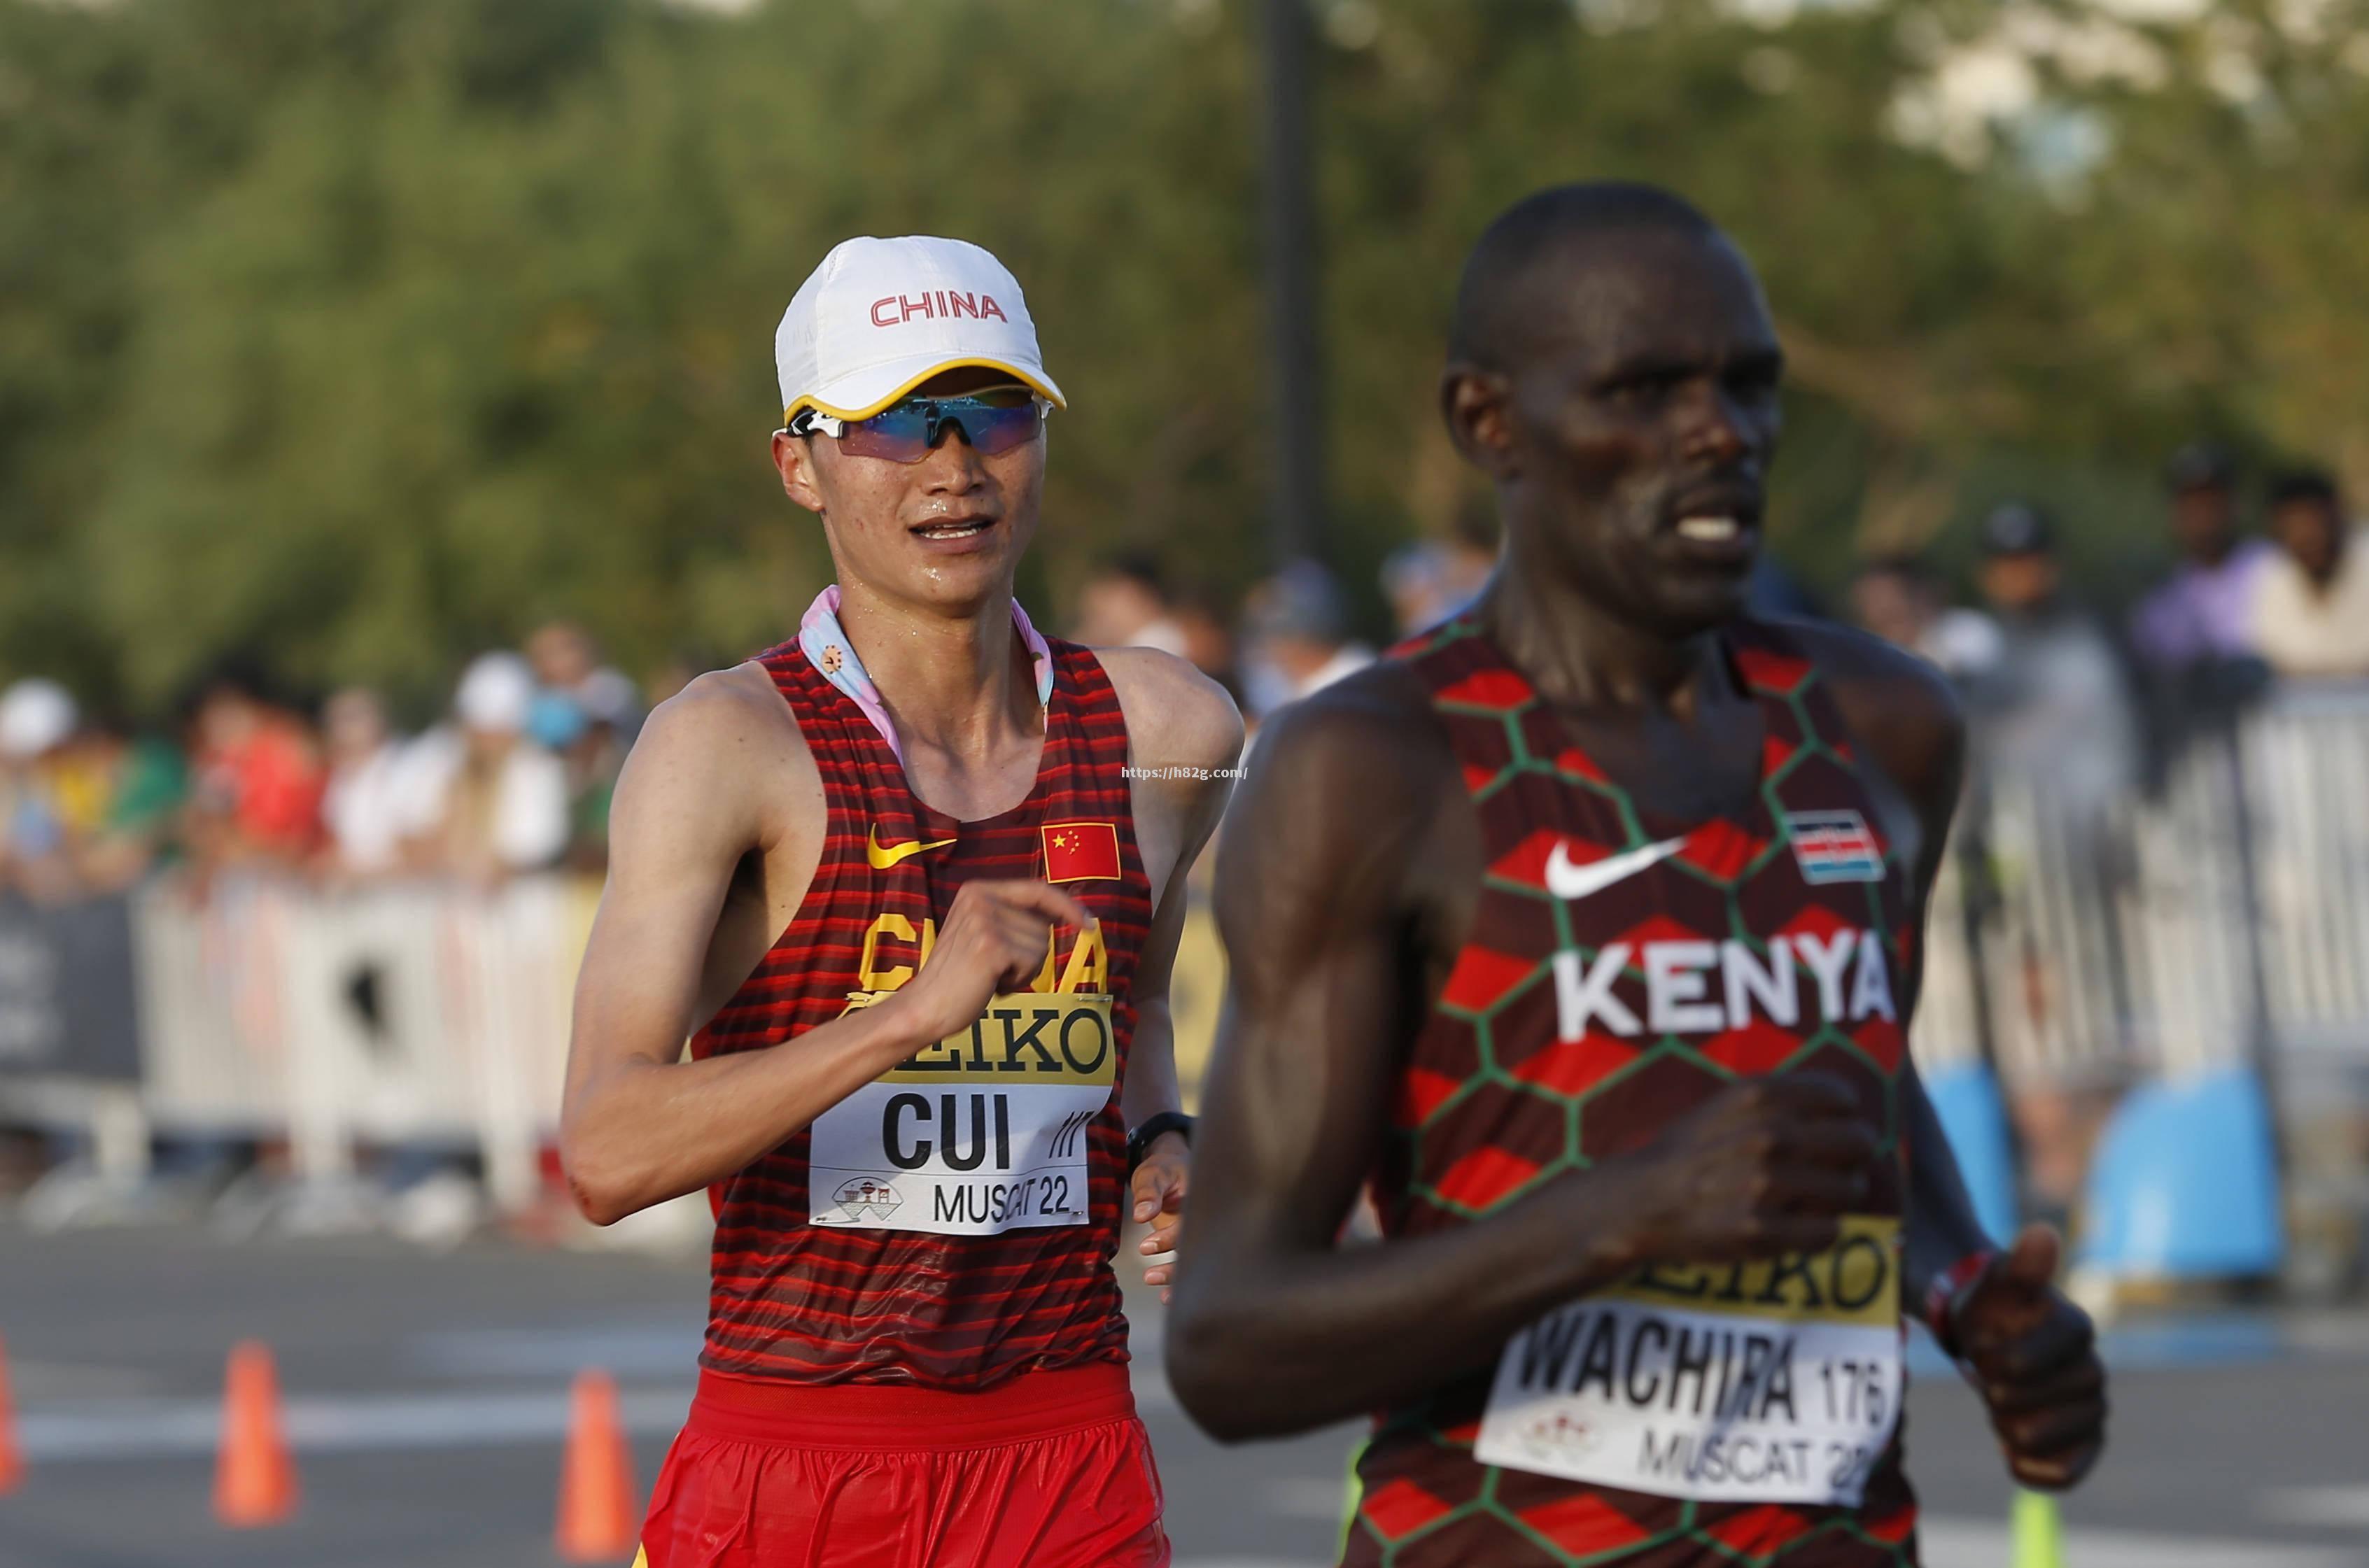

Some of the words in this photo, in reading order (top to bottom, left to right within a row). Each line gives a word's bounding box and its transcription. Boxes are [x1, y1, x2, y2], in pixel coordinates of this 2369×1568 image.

[870, 290, 1008, 327] CHINA
[1551, 926, 1897, 1045] KENYA
[845, 1006, 1107, 1075] IKO
[882, 1092, 1011, 1172] CUI
[933, 1177, 1036, 1224] MUSCAT
[1039, 1175, 1071, 1215] 22
[1625, 1233, 1889, 1311] EIKO
[1517, 1308, 1799, 1423] WACHIRA
[1820, 1358, 1887, 1427] 176
[1636, 1427, 1813, 1485] MUSCAT
